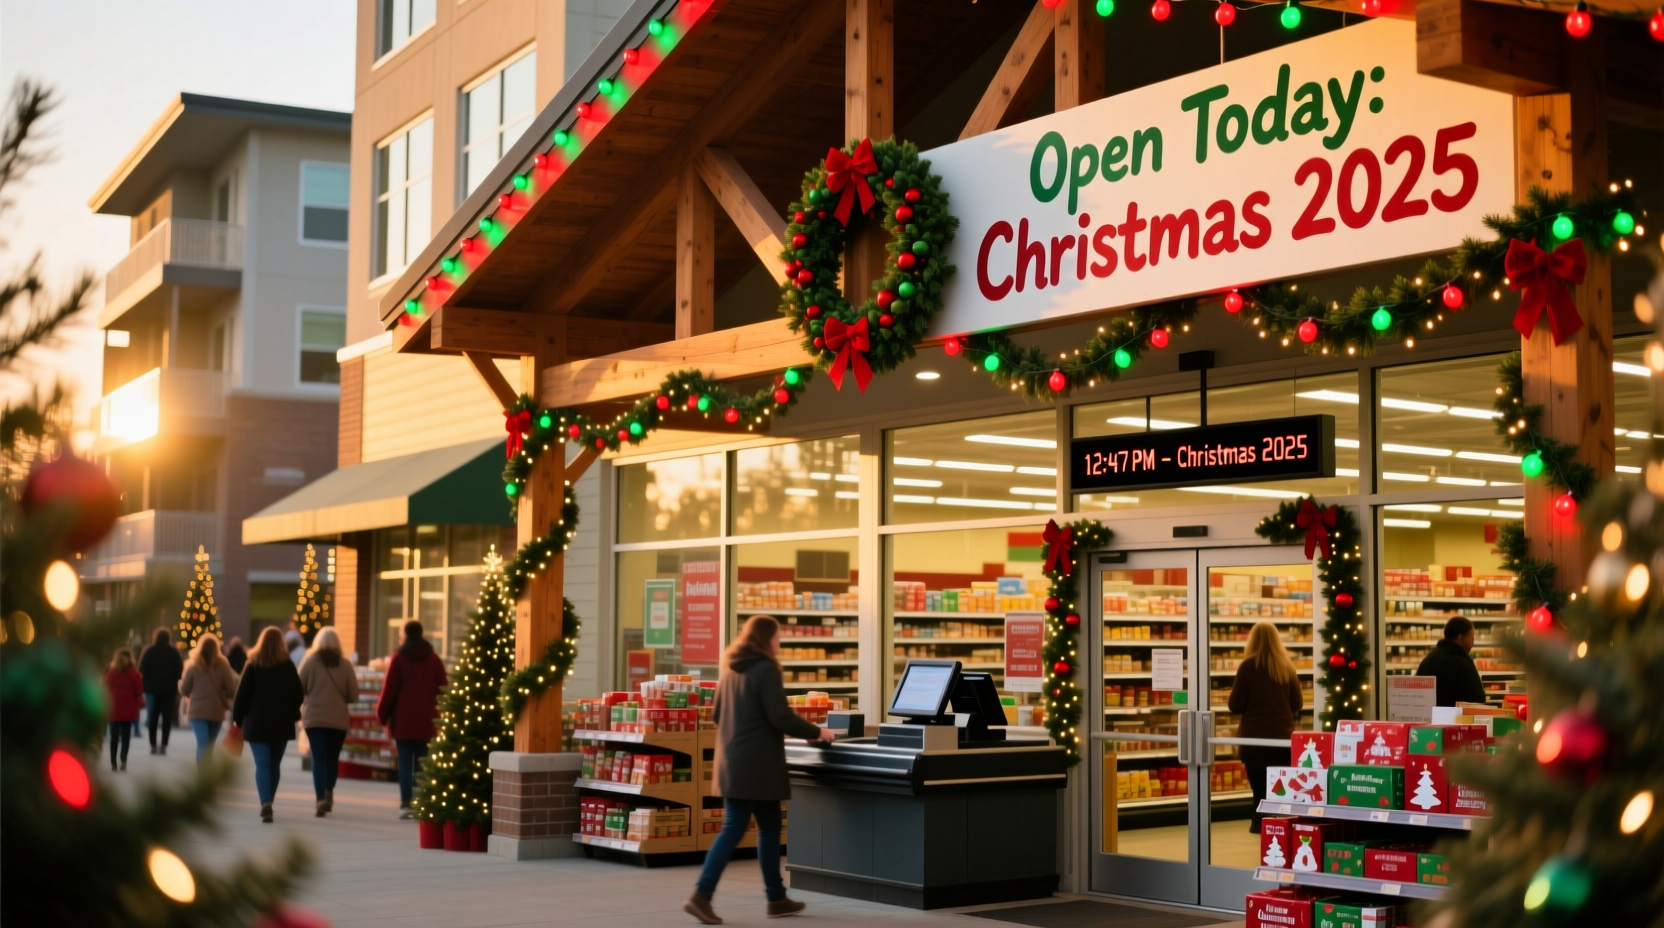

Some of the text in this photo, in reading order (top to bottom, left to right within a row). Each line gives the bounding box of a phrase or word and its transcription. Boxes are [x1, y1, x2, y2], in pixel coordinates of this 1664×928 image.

[976, 121, 1480, 302] Christmas 2025
[1029, 63, 1386, 216] Open Today:
[1177, 443, 1257, 468] Christmas
[1262, 434, 1308, 462] 2025
